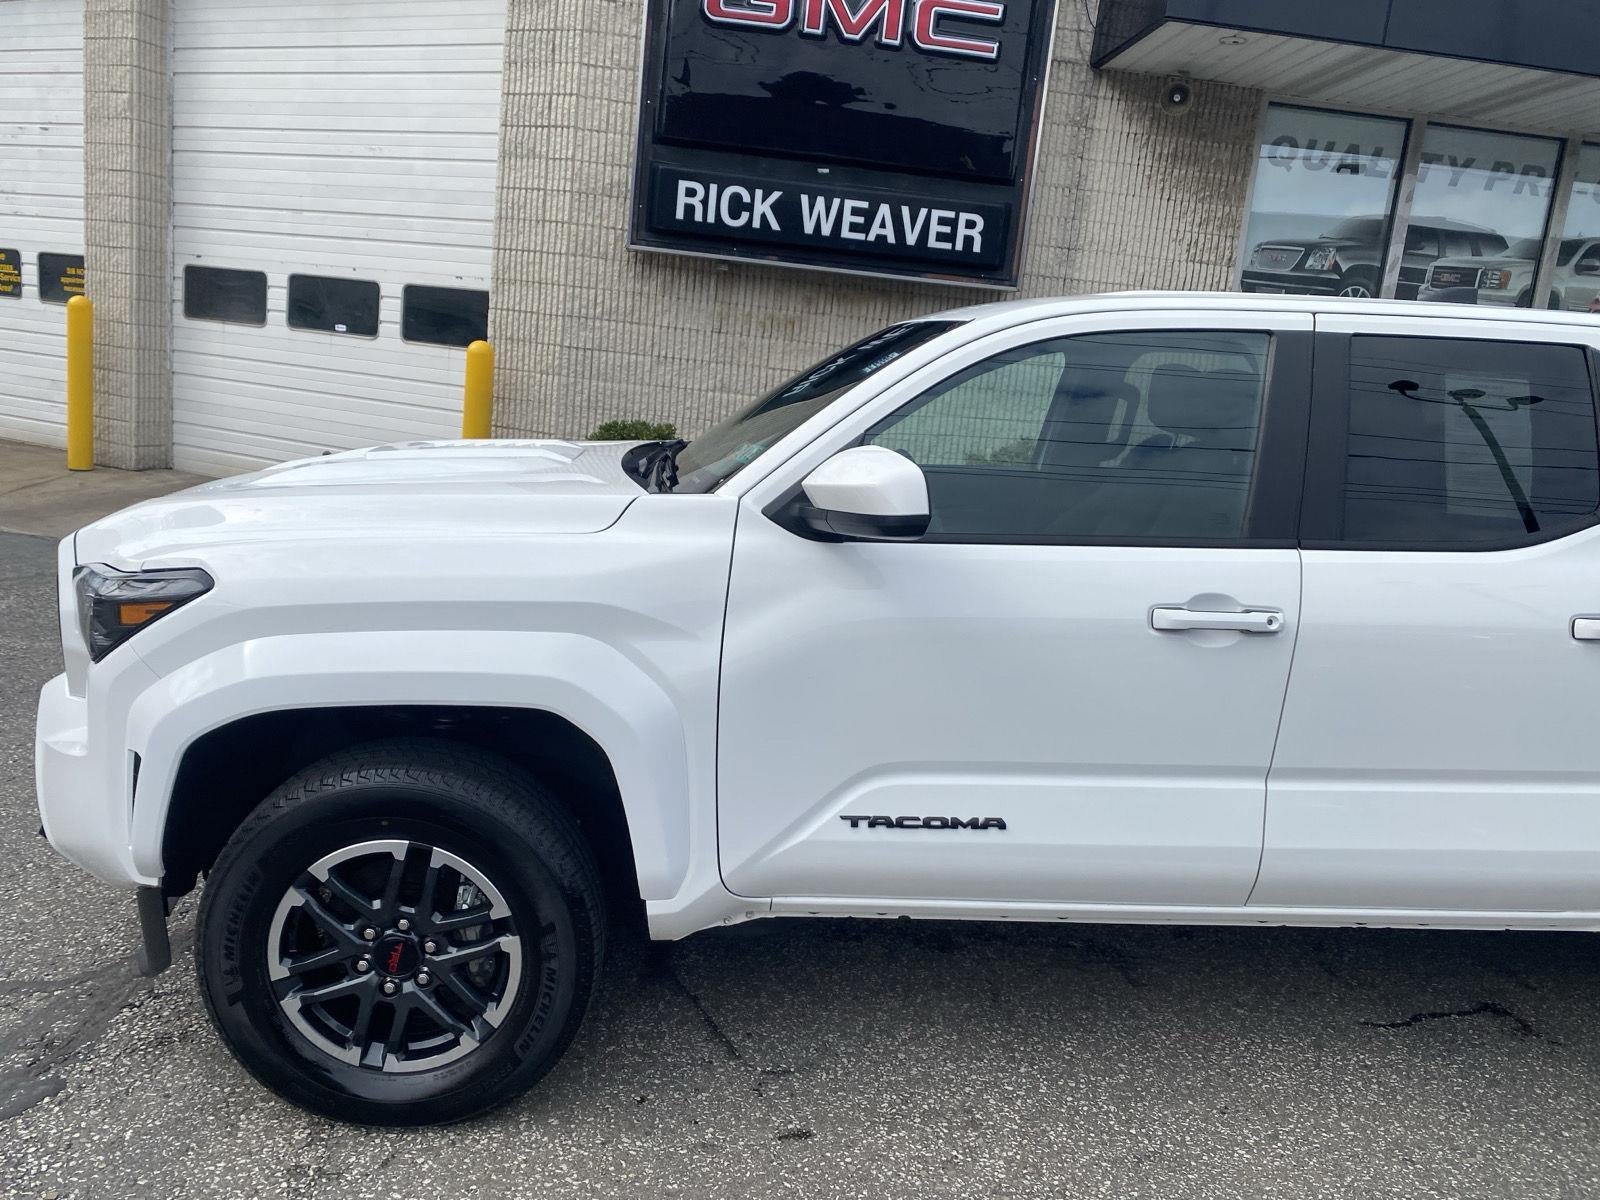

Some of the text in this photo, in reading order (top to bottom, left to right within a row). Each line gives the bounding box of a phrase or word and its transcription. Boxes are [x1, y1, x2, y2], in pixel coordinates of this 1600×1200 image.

[703, 0, 1004, 60] GMC
[1267, 135, 1476, 188] QUALTY
[675, 179, 985, 254] RICK WEAVER
[839, 815, 1007, 830] TACOMA
[518, 966, 557, 1054] MICHELIN
